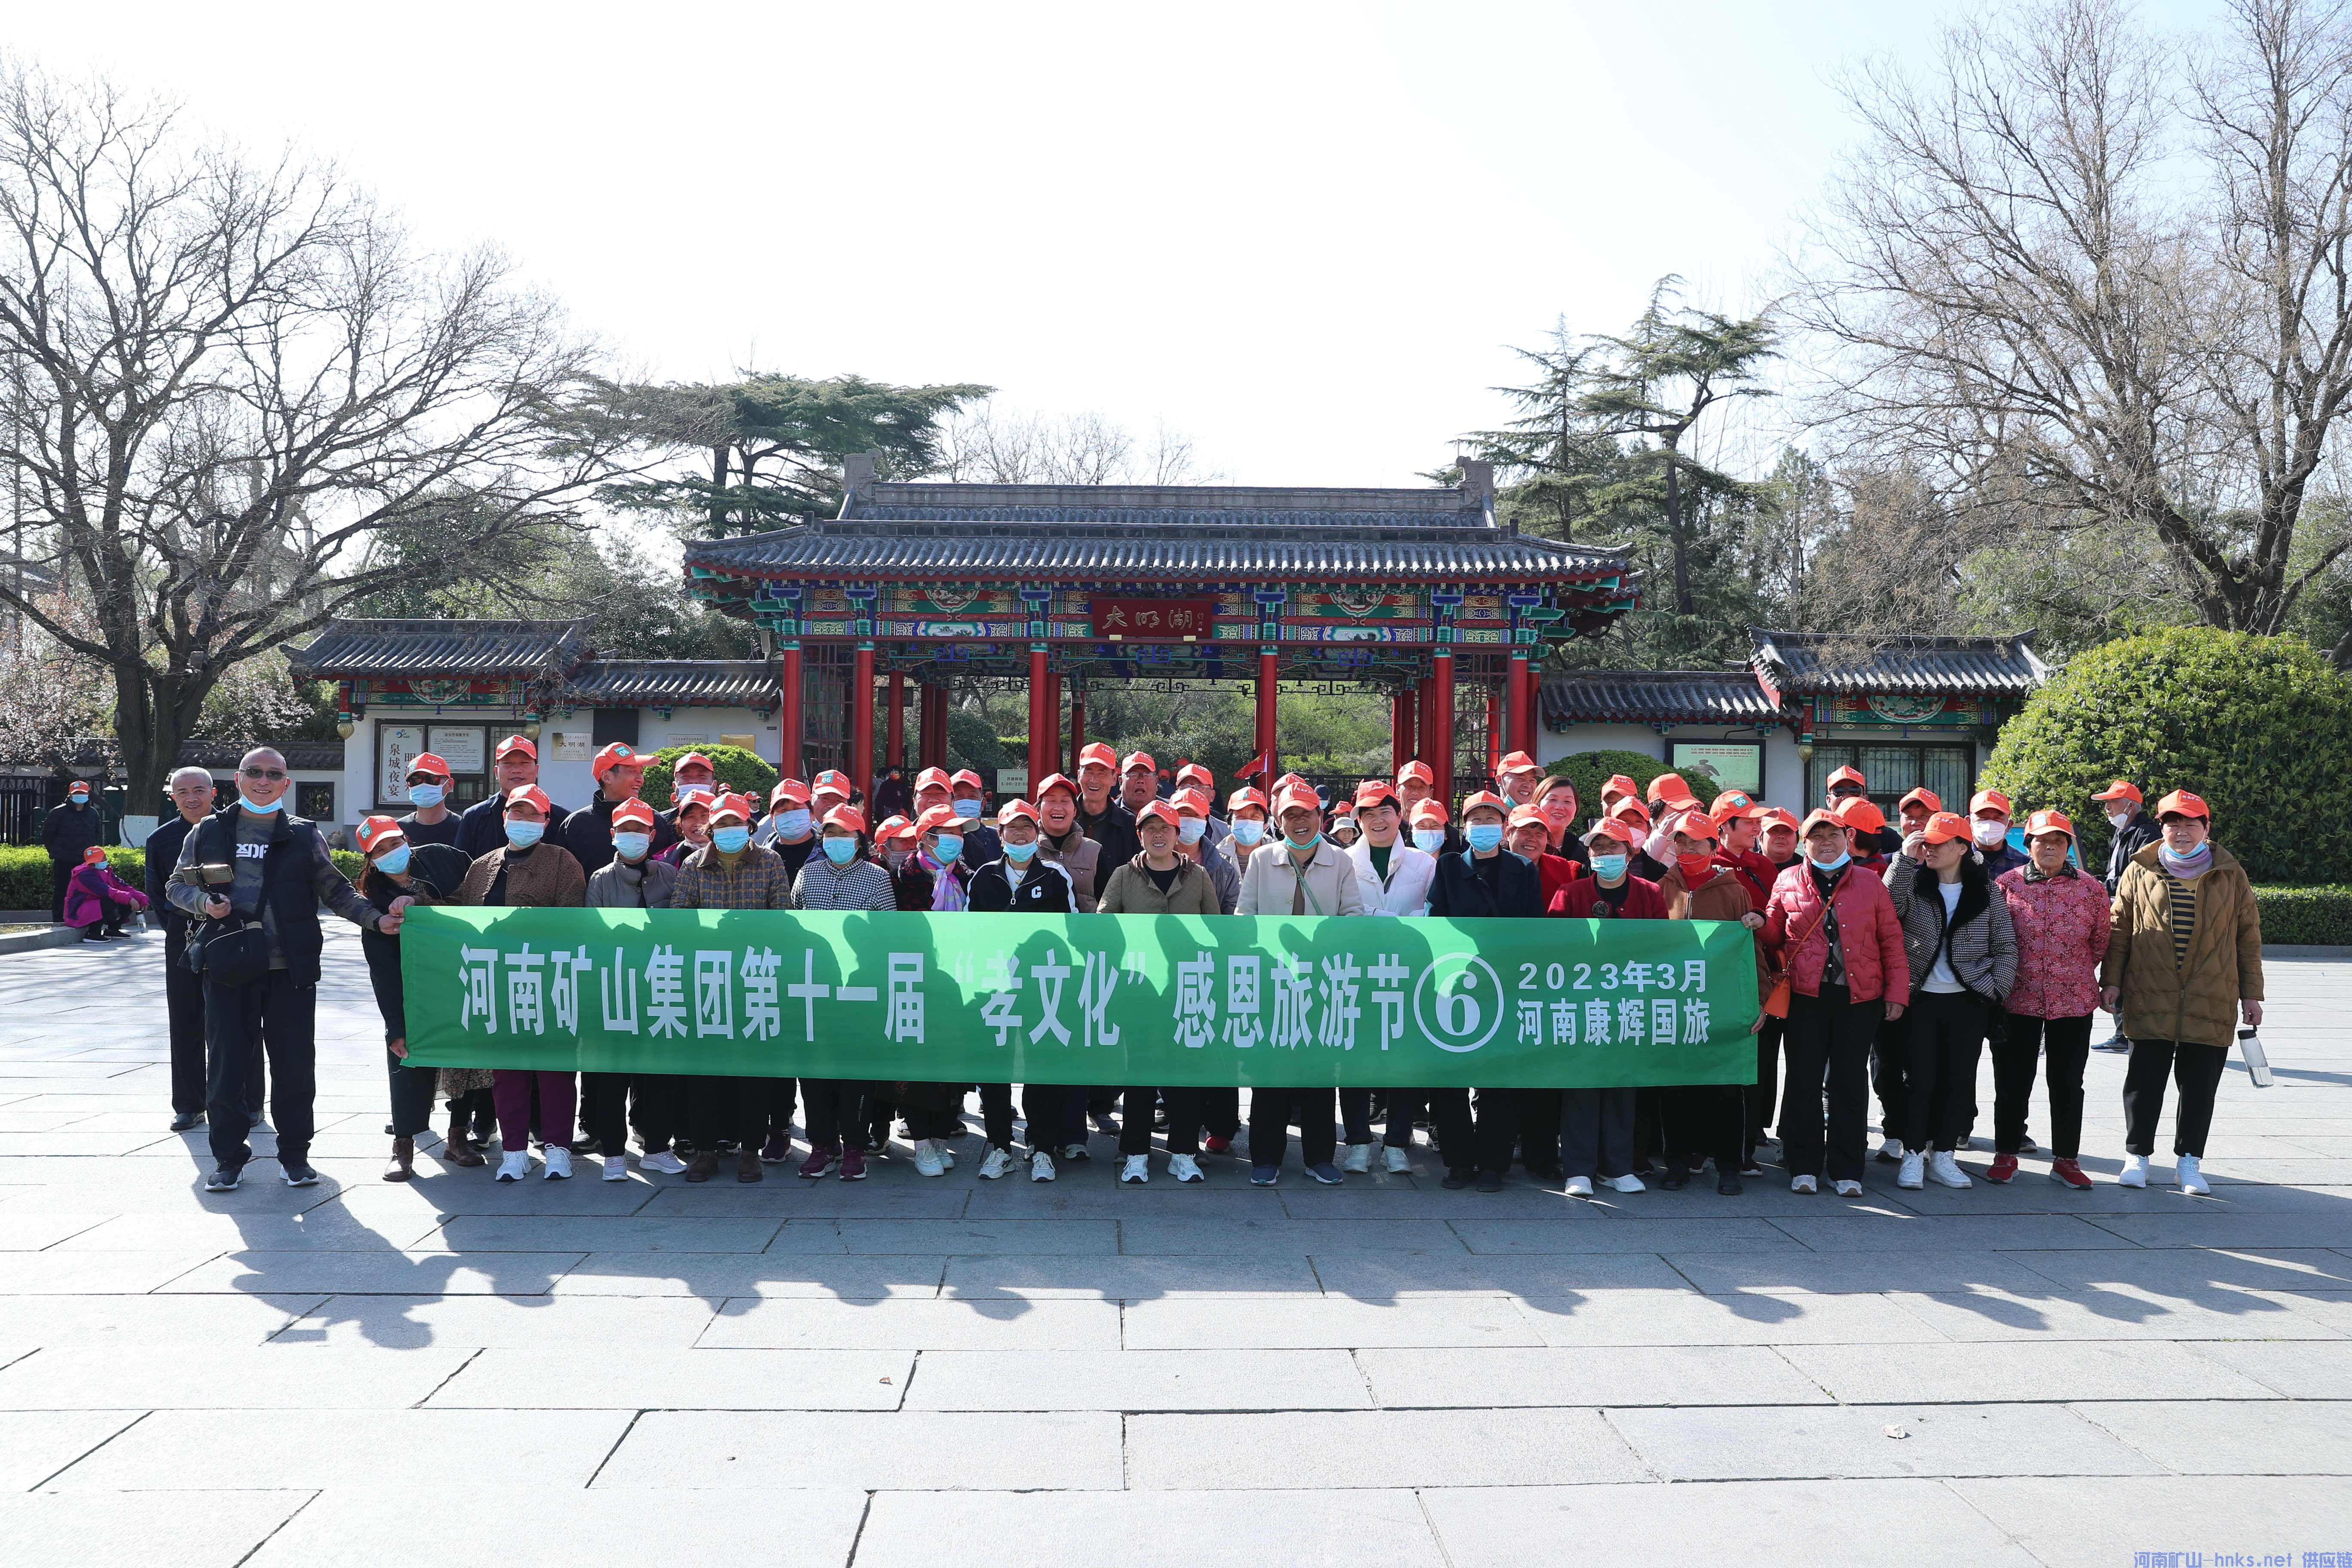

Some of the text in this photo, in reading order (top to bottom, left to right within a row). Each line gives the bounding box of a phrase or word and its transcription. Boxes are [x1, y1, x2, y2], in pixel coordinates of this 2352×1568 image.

[1102, 606, 1194, 629] 大明湖
[388, 744, 401, 796] 泉城夜宴
[1735, 798, 1746, 806] 06
[362, 827, 370, 839] 06
[1032, 885, 1042, 898] C
[1519, 960, 1706, 992] 2023年3月
[1517, 997, 1710, 1046] 河南康辉国旅
